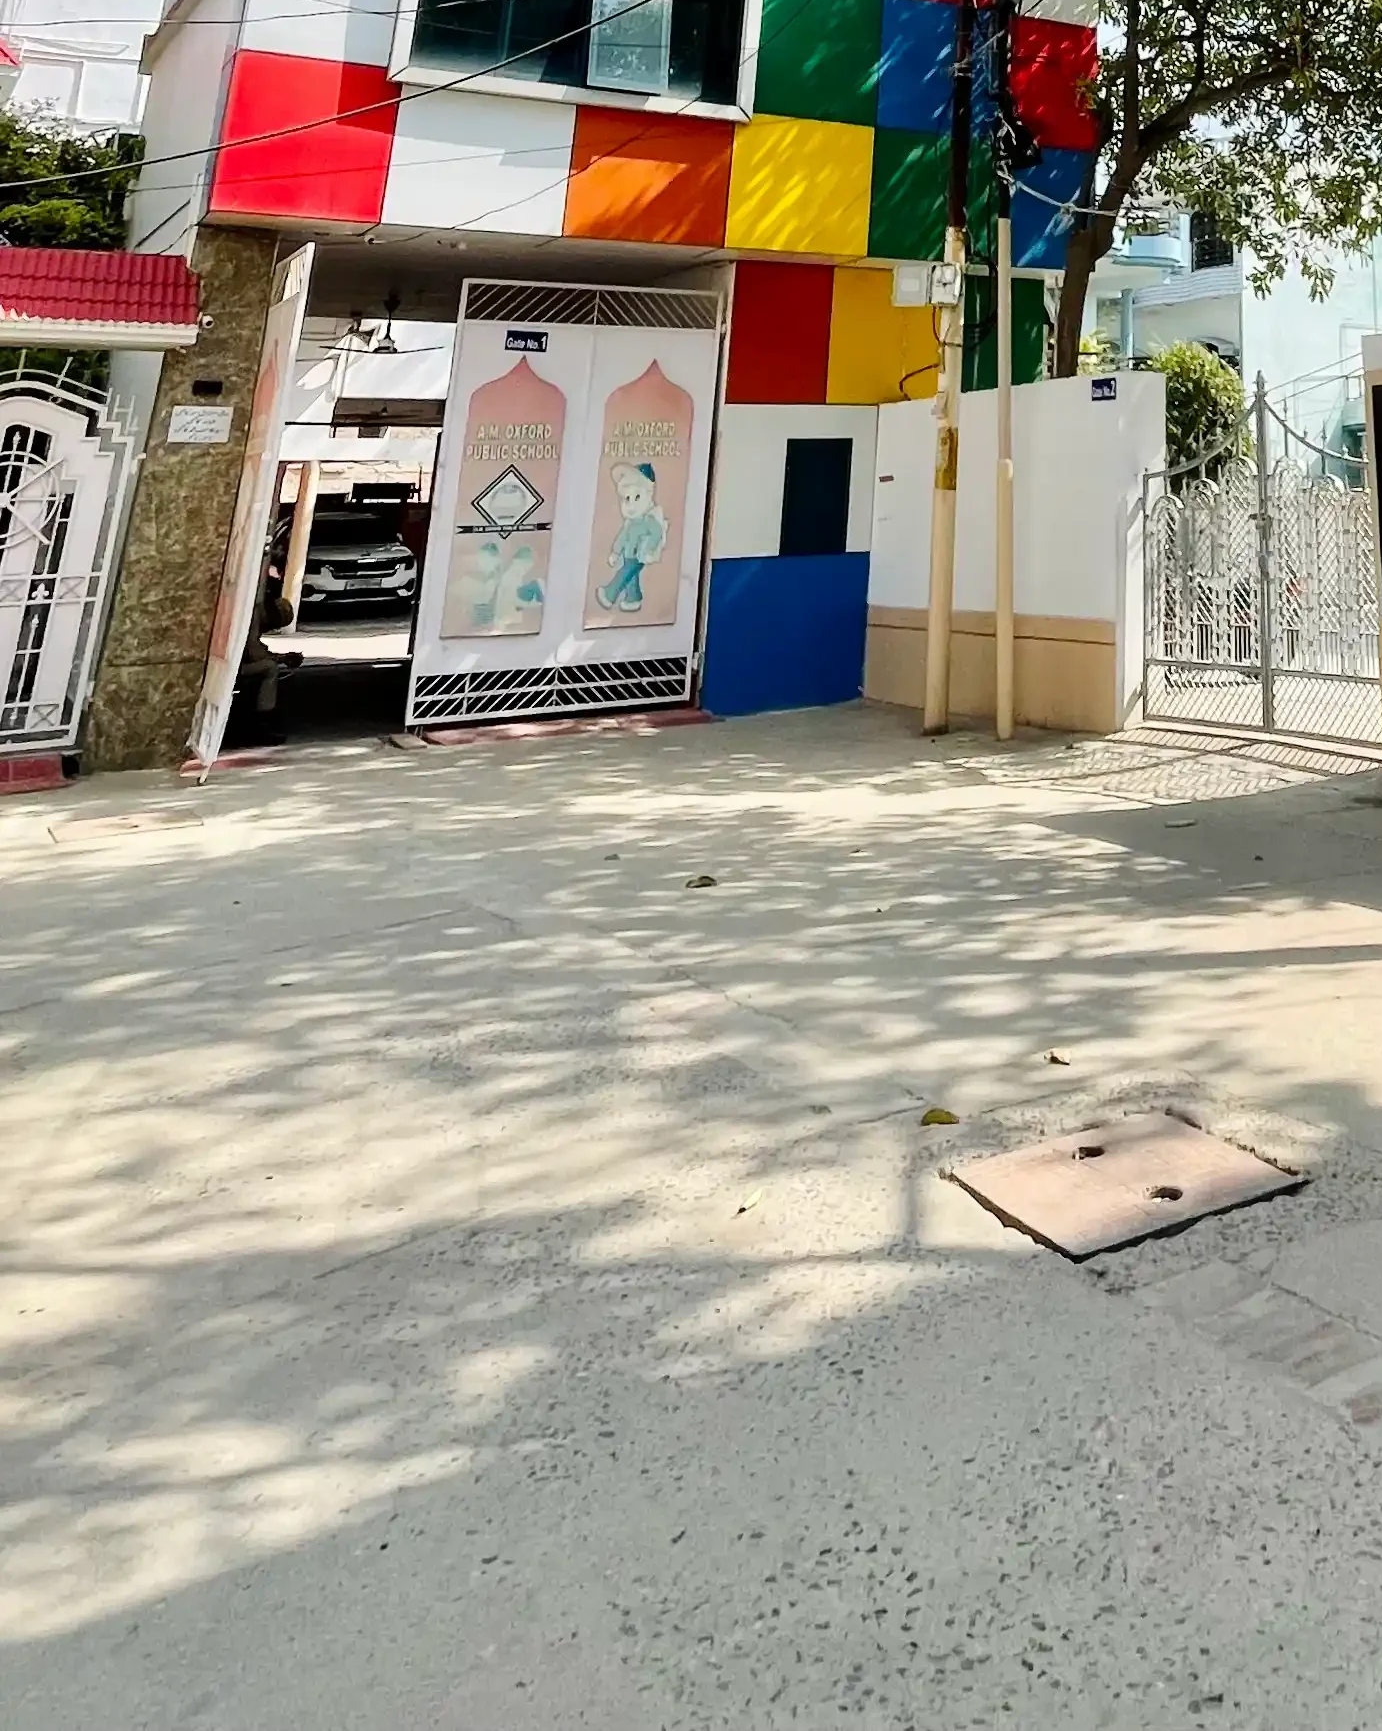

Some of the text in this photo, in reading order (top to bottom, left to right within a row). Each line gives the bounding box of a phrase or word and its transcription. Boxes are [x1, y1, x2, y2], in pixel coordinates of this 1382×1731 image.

[507, 337, 525, 349] Gate
[541, 335, 547, 350] 1
[505, 424, 552, 440] OXFORD
[637, 421, 675, 437] OXFORD
[466, 444, 558, 460] PUBLIC SCHOOL
[604, 441, 681, 457] PUBLIC SCHOOL
